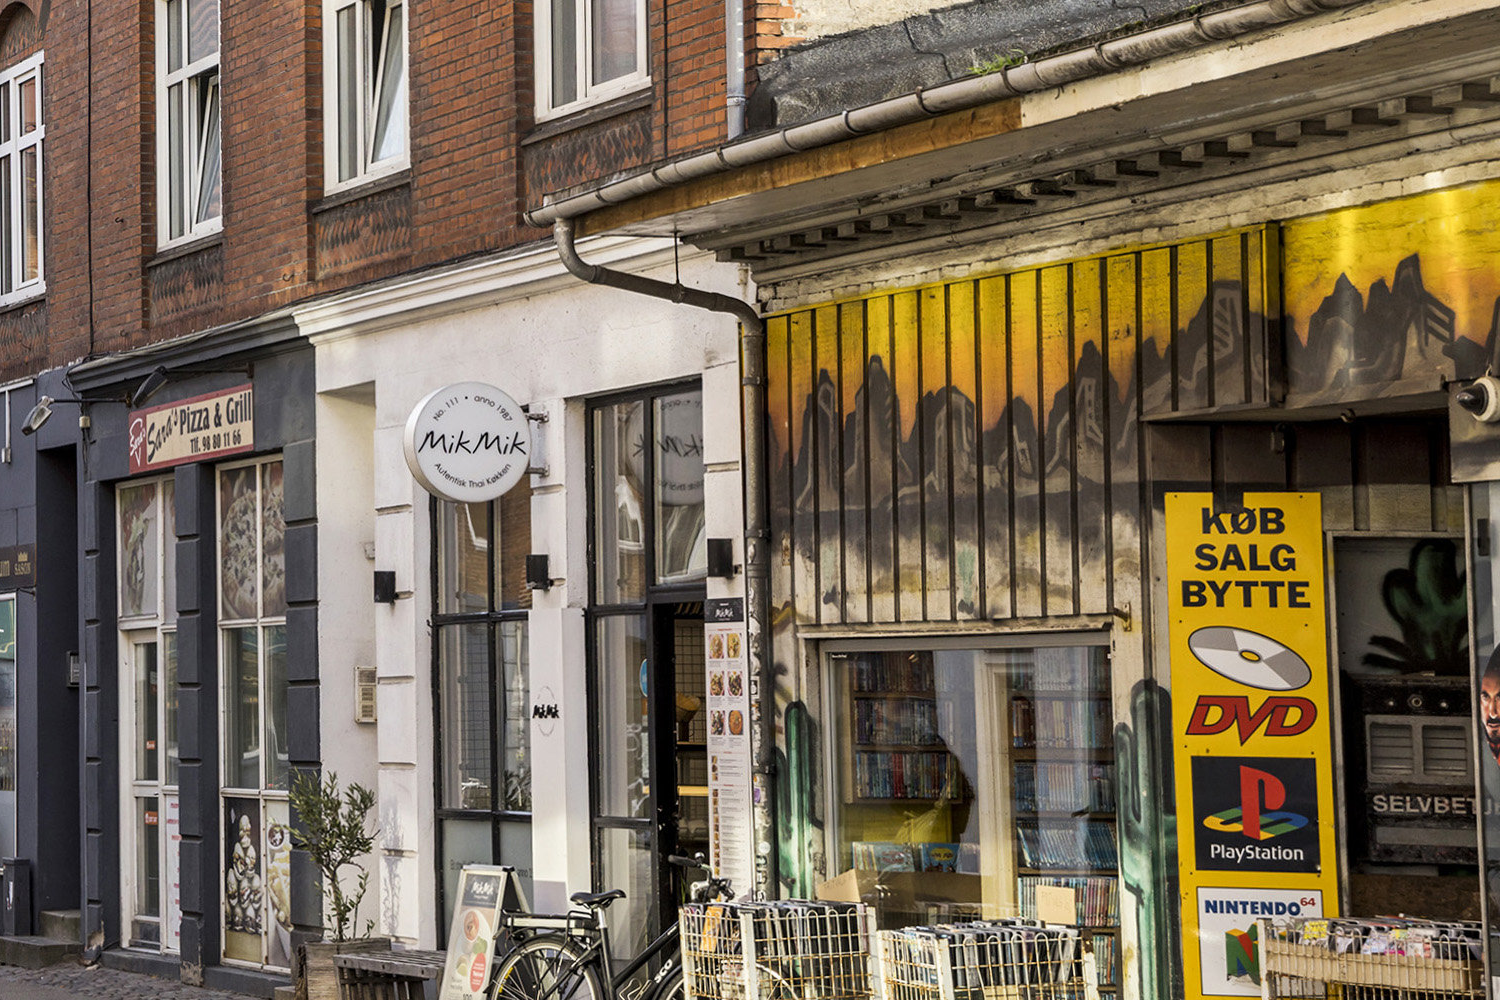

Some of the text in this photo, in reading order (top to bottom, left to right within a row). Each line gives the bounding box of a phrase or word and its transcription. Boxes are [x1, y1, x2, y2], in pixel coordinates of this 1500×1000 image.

[474, 395, 495, 408] anno
[497, 405, 513, 422] 1987
[147, 392, 252, 462] Sara's Pizza & Grill
[190, 430, 241, 454] Tlf. 98 80 11 66
[418, 430, 526, 455] MikMik
[435, 463, 512, 488] Autentisk Thai Køkken
[1201, 507, 1286, 535] KØB
[14, 561, 31, 576] SASON
[1194, 543, 1297, 572] SALG
[1181, 580, 1311, 609] BYTTE
[1185, 695, 1318, 747] DVD
[1210, 844, 1305, 864] PlayStation
[1204, 897, 1316, 916] NINTENDO 64
[654, 959, 673, 984] SCO
